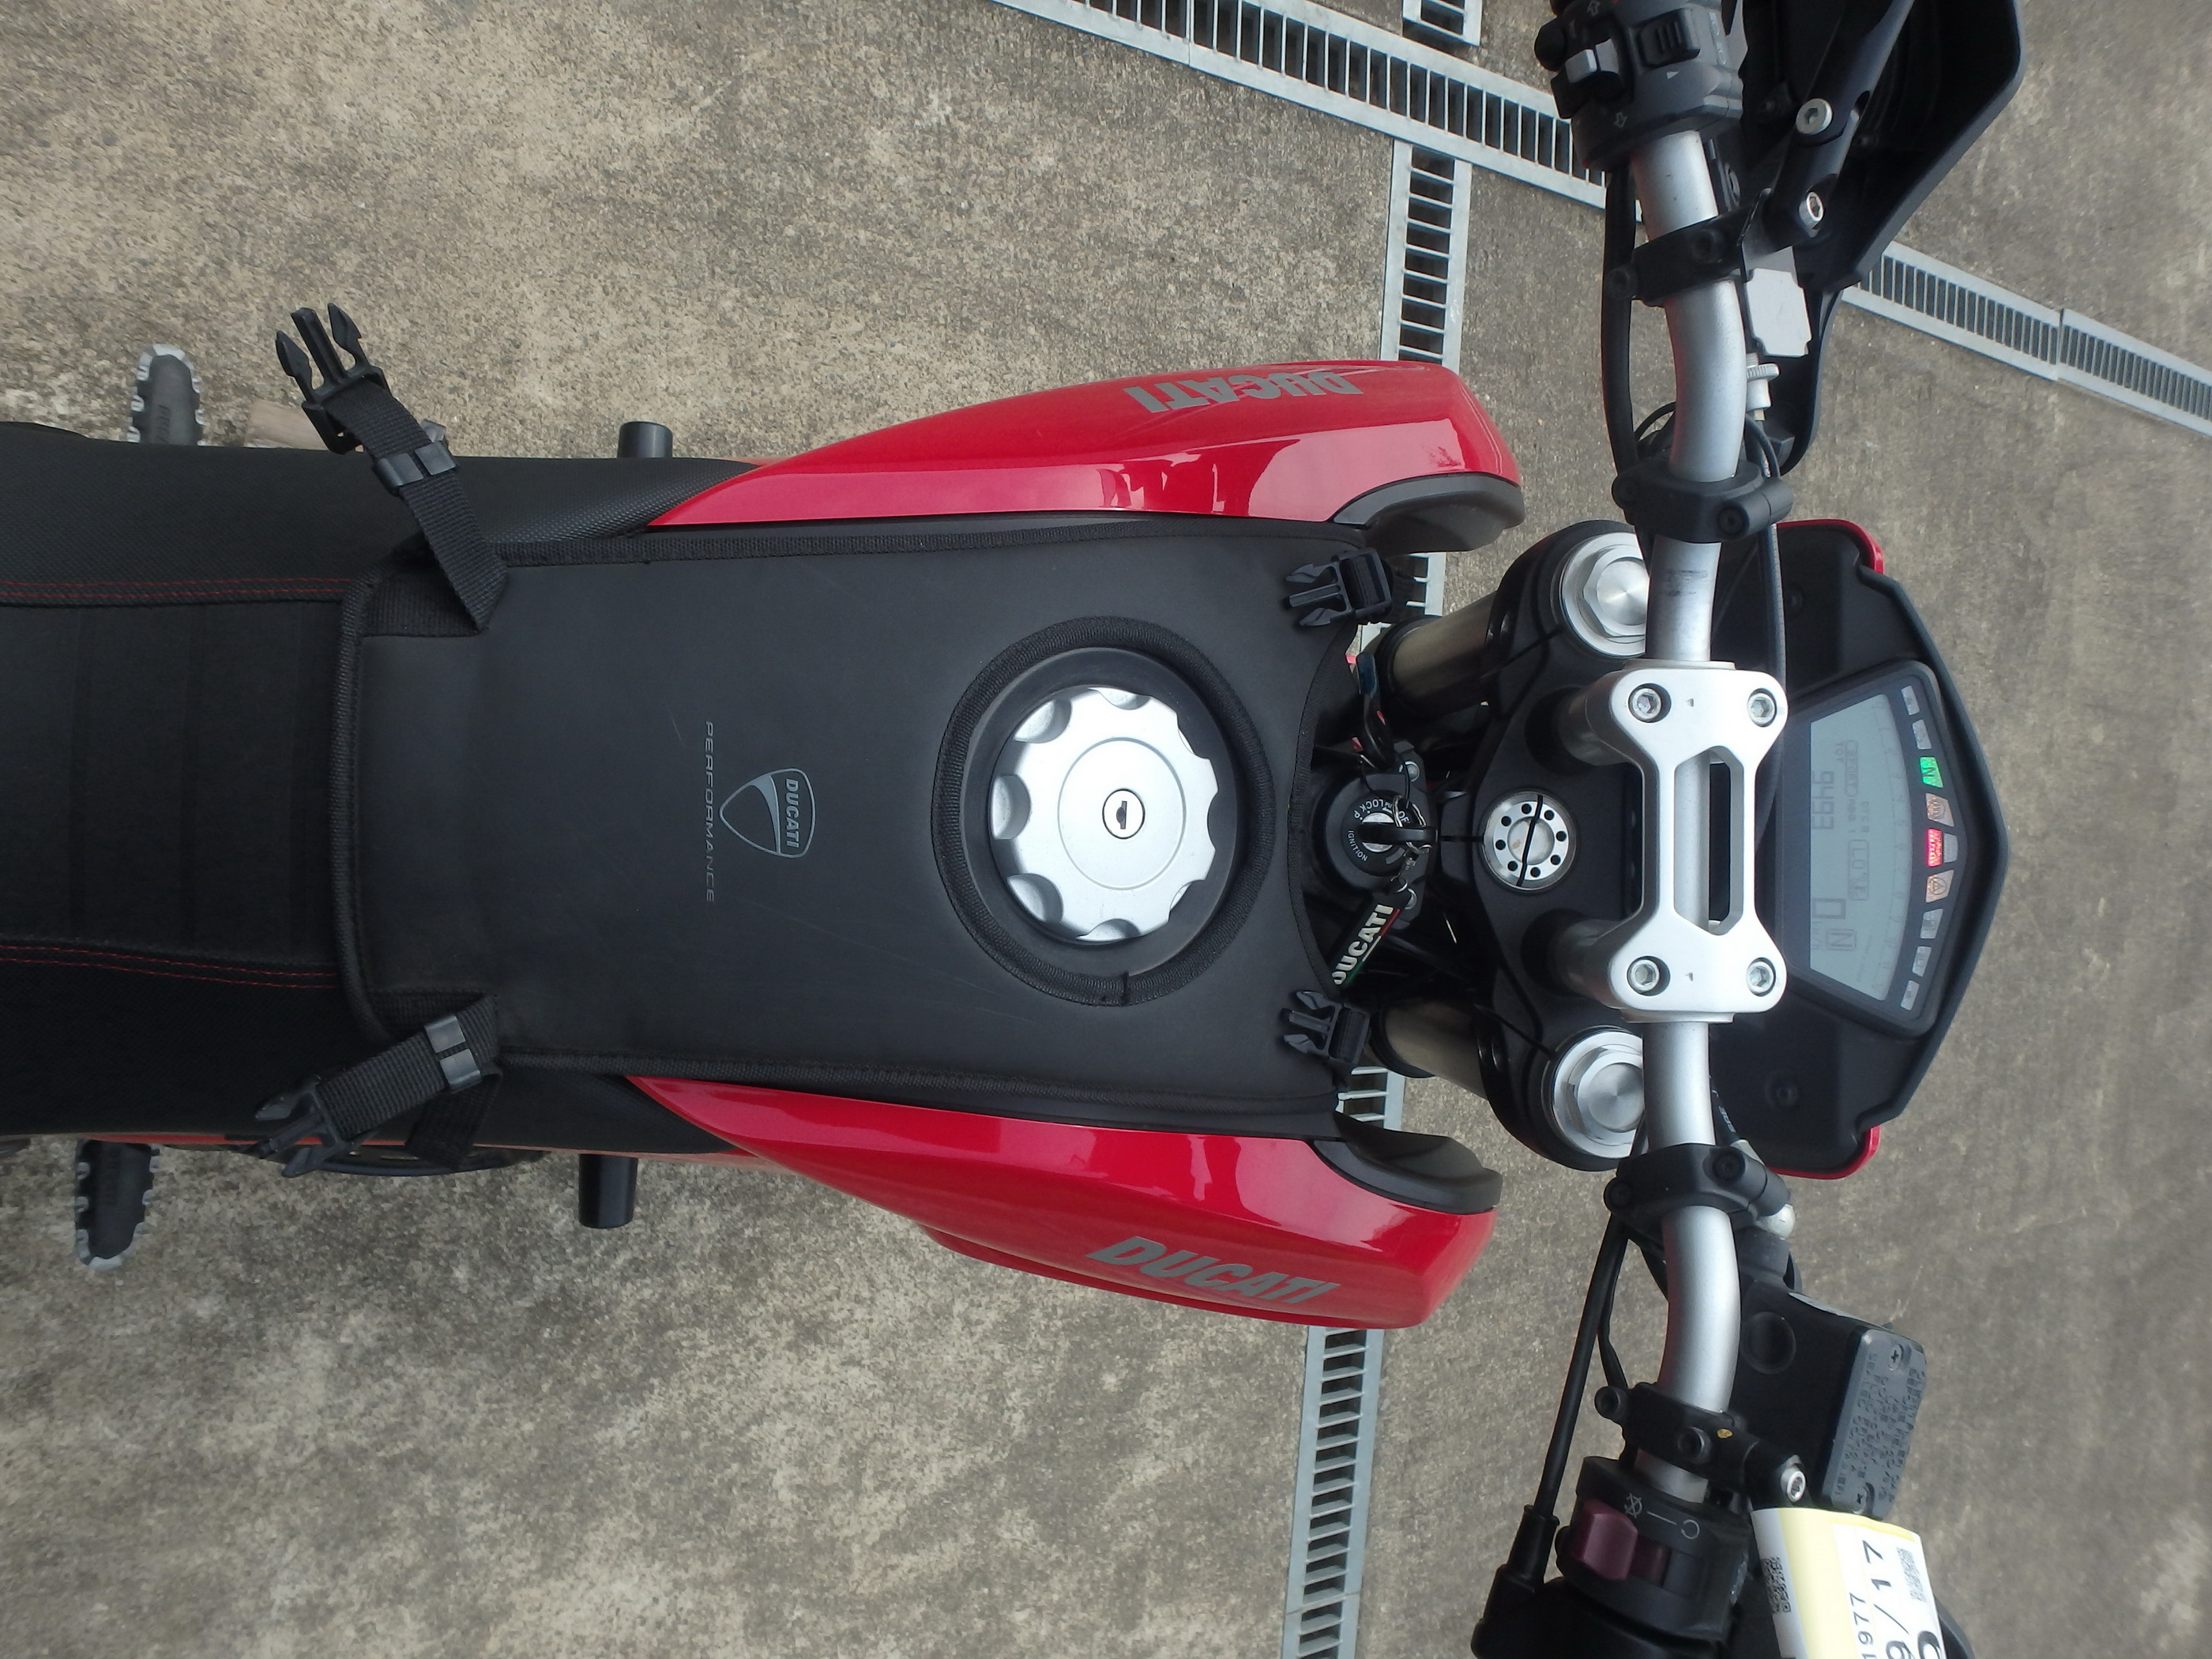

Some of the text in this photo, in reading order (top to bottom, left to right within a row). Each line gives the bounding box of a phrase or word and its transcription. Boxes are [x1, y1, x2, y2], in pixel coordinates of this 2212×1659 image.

[1123, 371, 1364, 413] DUCATI
[1835, 742, 1845, 763] TOT
[705, 721, 714, 901] PERFORMANCE
[785, 778, 799, 848] DUCATI
[1360, 799, 1383, 812] LOCK
[1811, 770, 1834, 830] 9493
[1348, 830, 1368, 863] IGNITION
[1332, 904, 1394, 985] DUCATI
[1830, 932, 1853, 948] N
[1085, 1236, 1341, 1304] DUCATI
